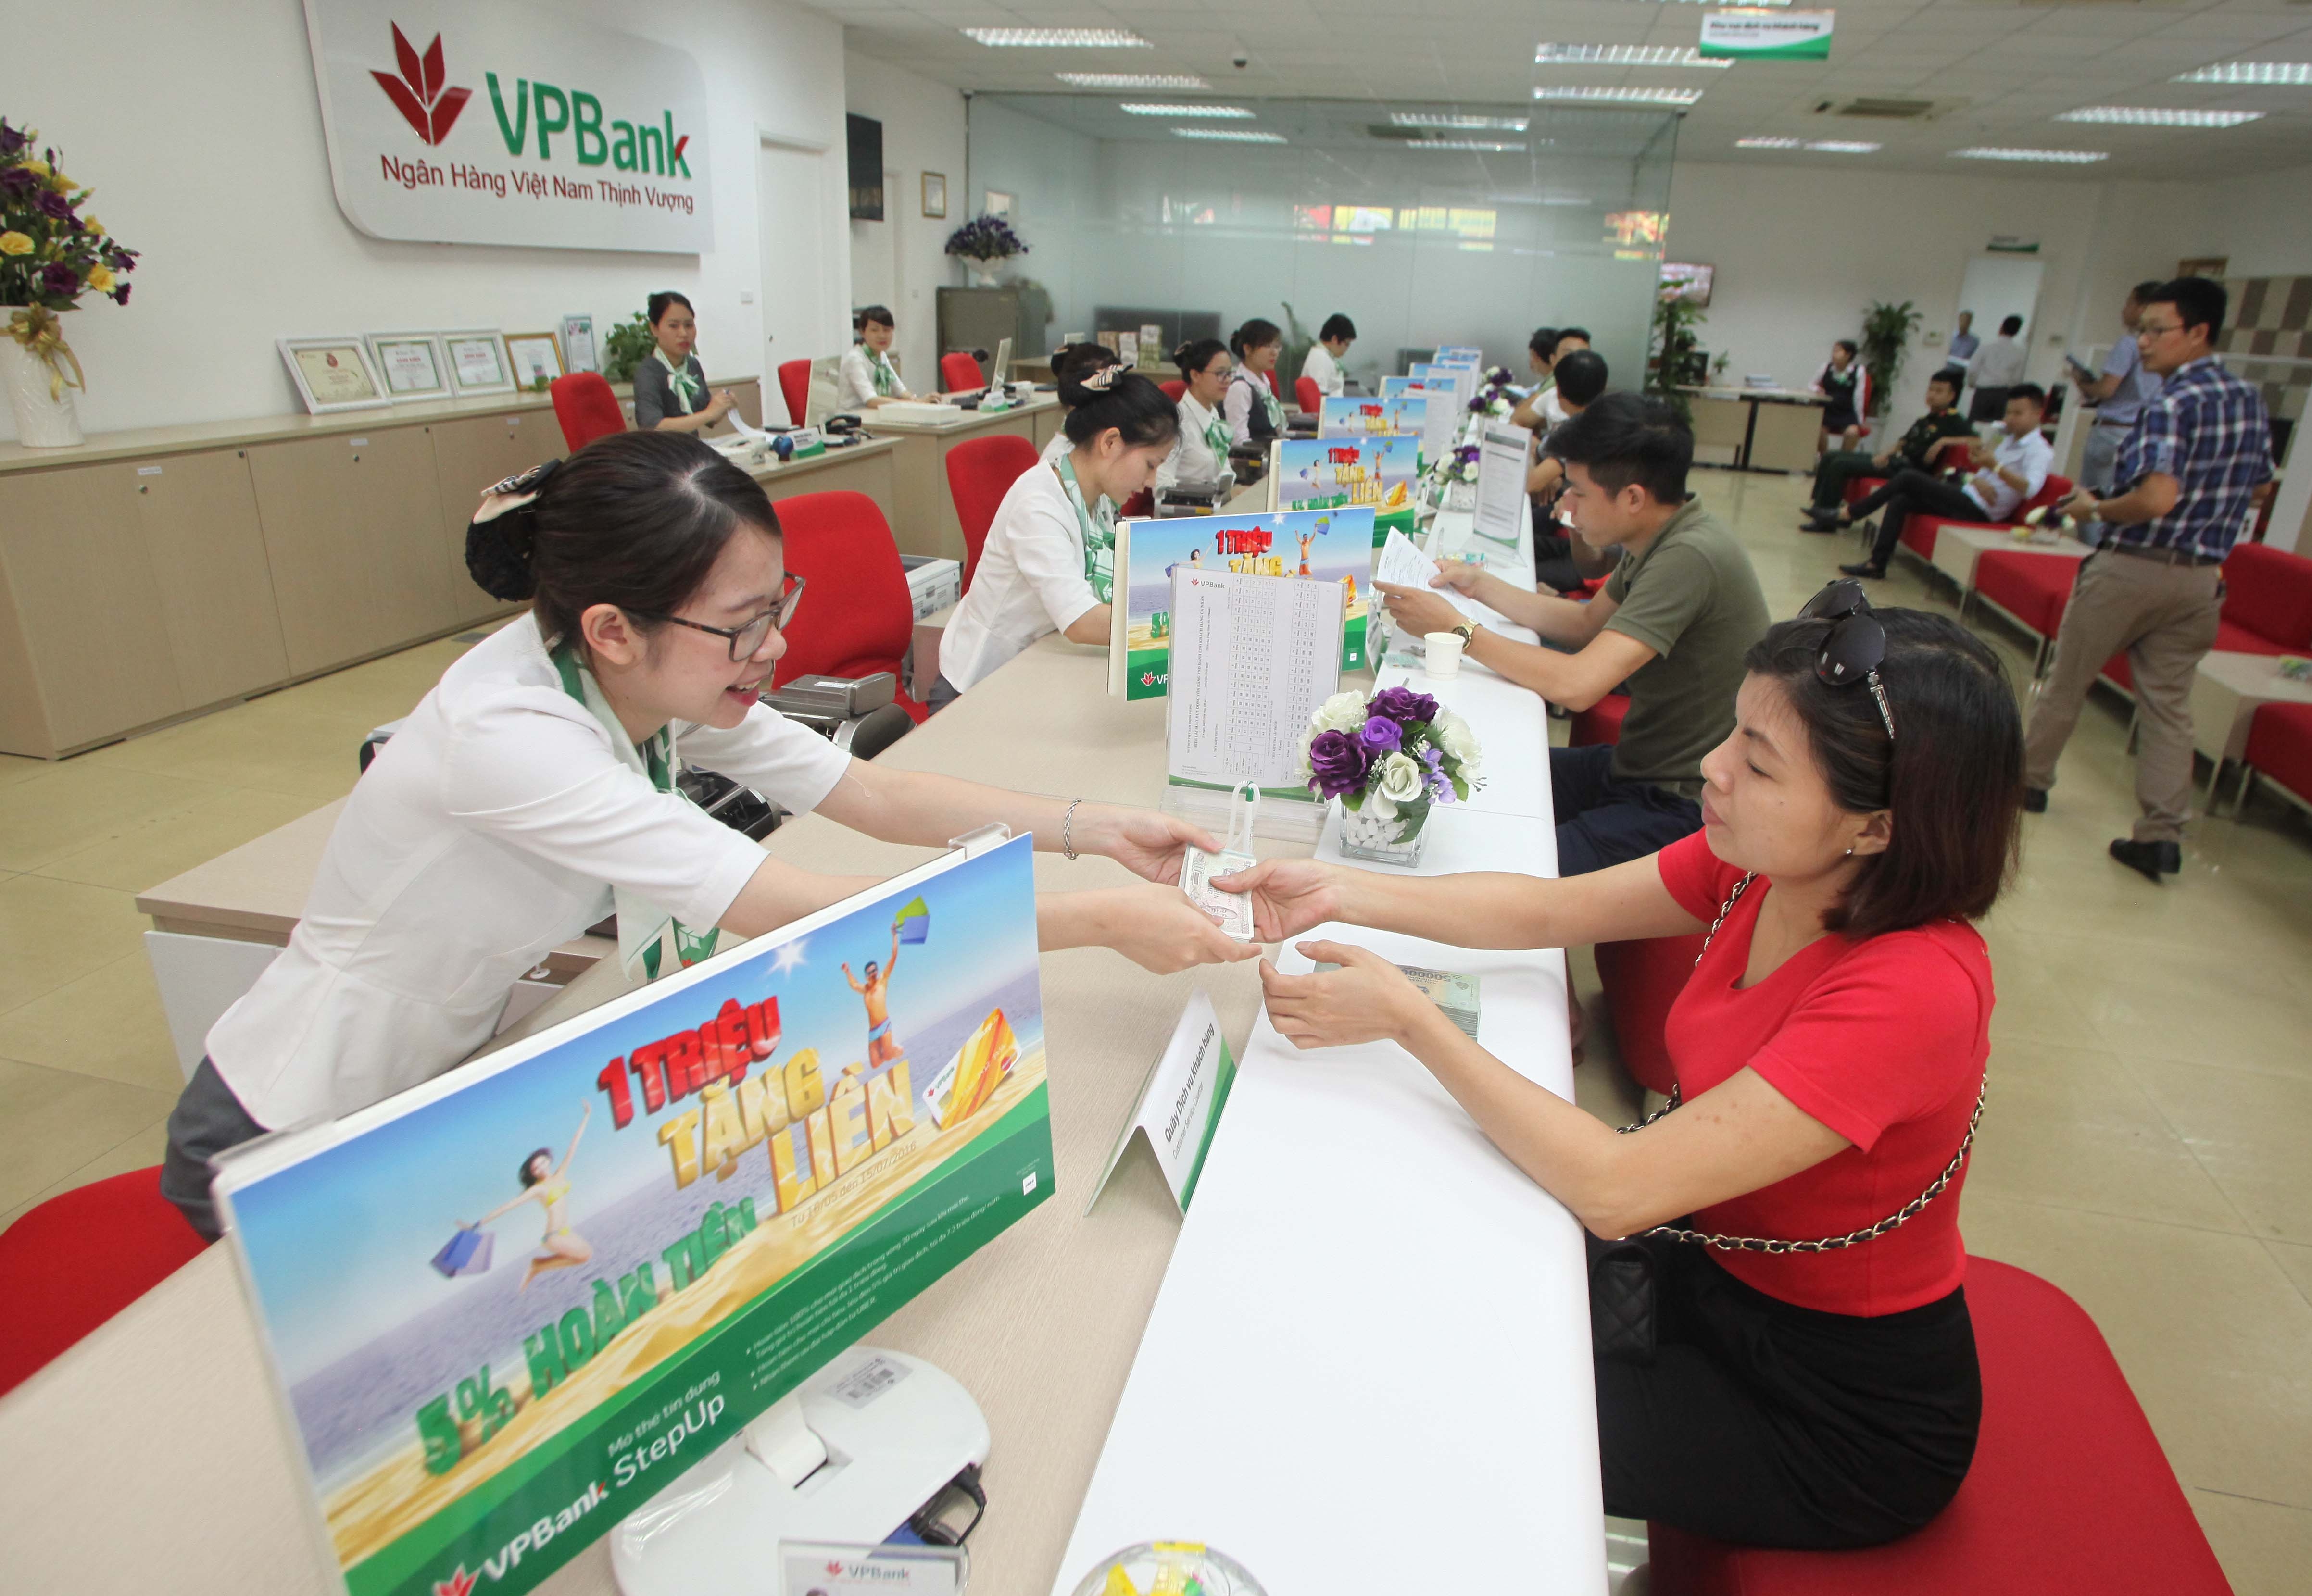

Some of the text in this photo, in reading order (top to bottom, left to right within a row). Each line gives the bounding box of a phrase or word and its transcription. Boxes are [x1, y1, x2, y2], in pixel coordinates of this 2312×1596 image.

[485, 72, 692, 178] VPBank
[380, 154, 694, 214] Ngân Hàng Việt Nam Thịnh Vượng
[1328, 448, 1333, 463] 1
[1200, 580, 1225, 589] VPBank
[1215, 526, 1272, 558] 1 TRIỆU
[597, 995, 782, 1131] 1 TRIỆU
[1164, 1022, 1215, 1143] Quầy Dịch vụ khách hàng
[658, 1047, 825, 1191] TẶNG
[766, 1059, 916, 1216] LIỀN
[1173, 1082, 1204, 1160] Customer Service Counter
[415, 1196, 758, 1475] 5% HOÀN TIỀN
[482, 1394, 725, 1581] VPBank StepUp
[848, 1564, 910, 1580] VPBank
